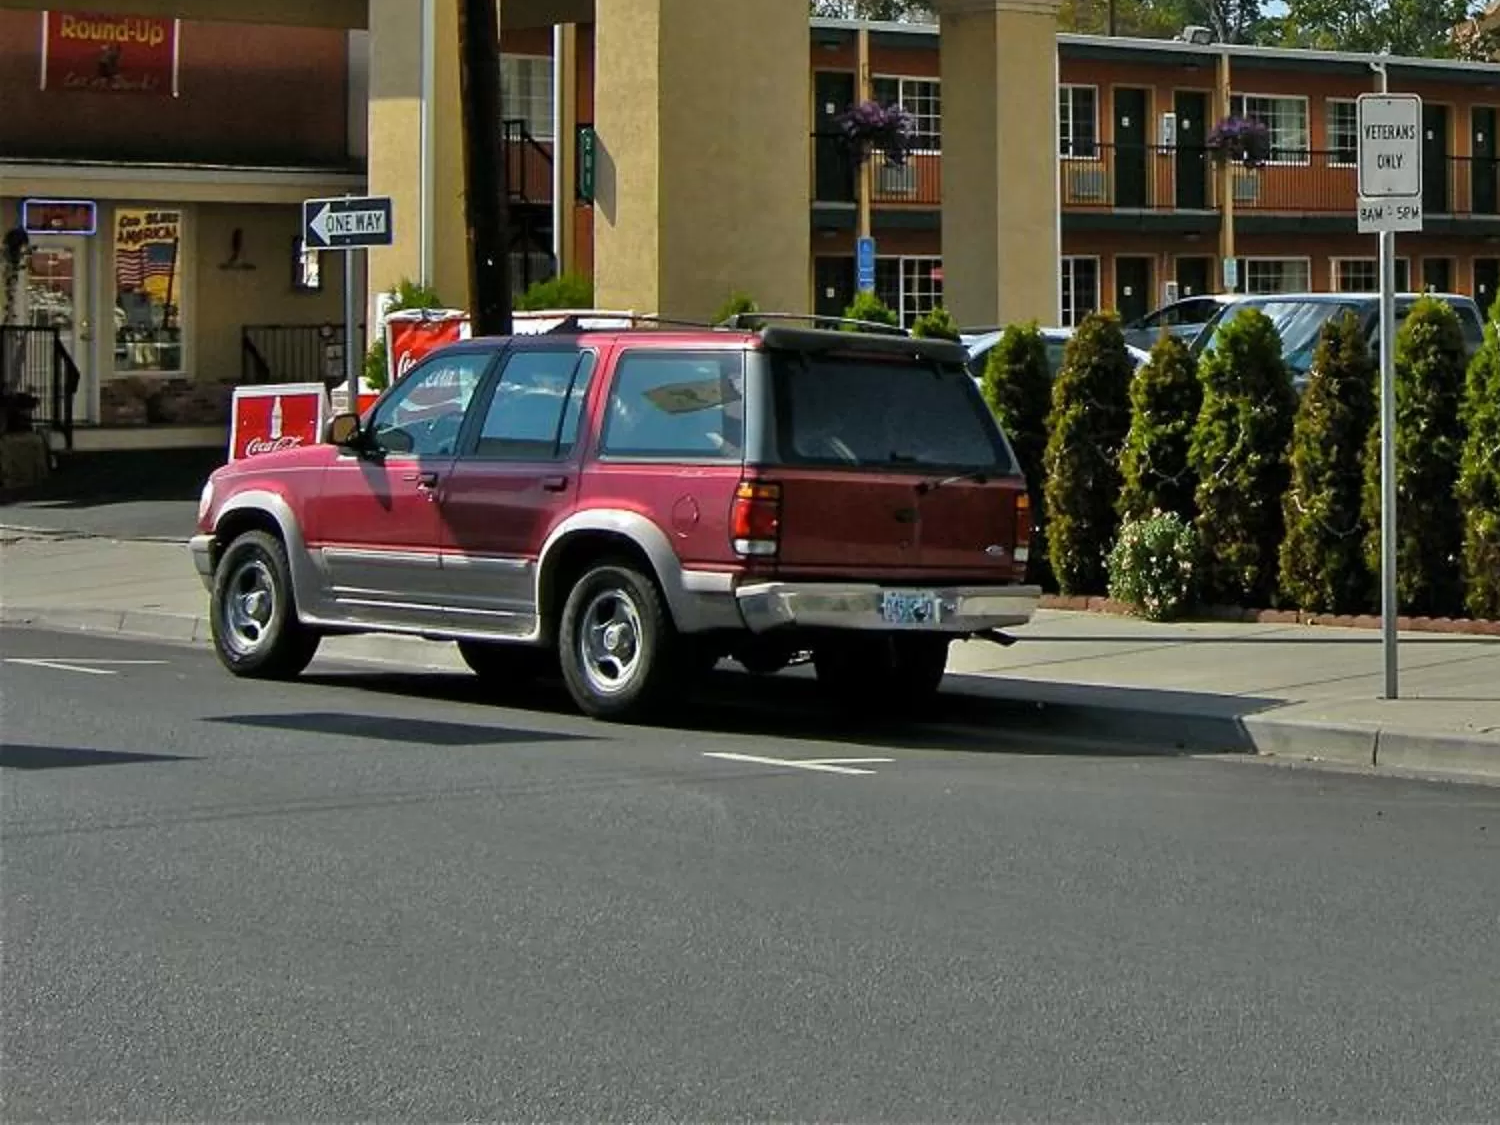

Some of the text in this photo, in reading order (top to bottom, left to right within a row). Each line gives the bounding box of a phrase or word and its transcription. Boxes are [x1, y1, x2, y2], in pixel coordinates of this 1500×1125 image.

[61, 15, 165, 47] Round-Up
[1364, 125, 1416, 140] VETERANS
[1377, 154, 1403, 169] ONLY
[326, 213, 382, 233] ONE WAY
